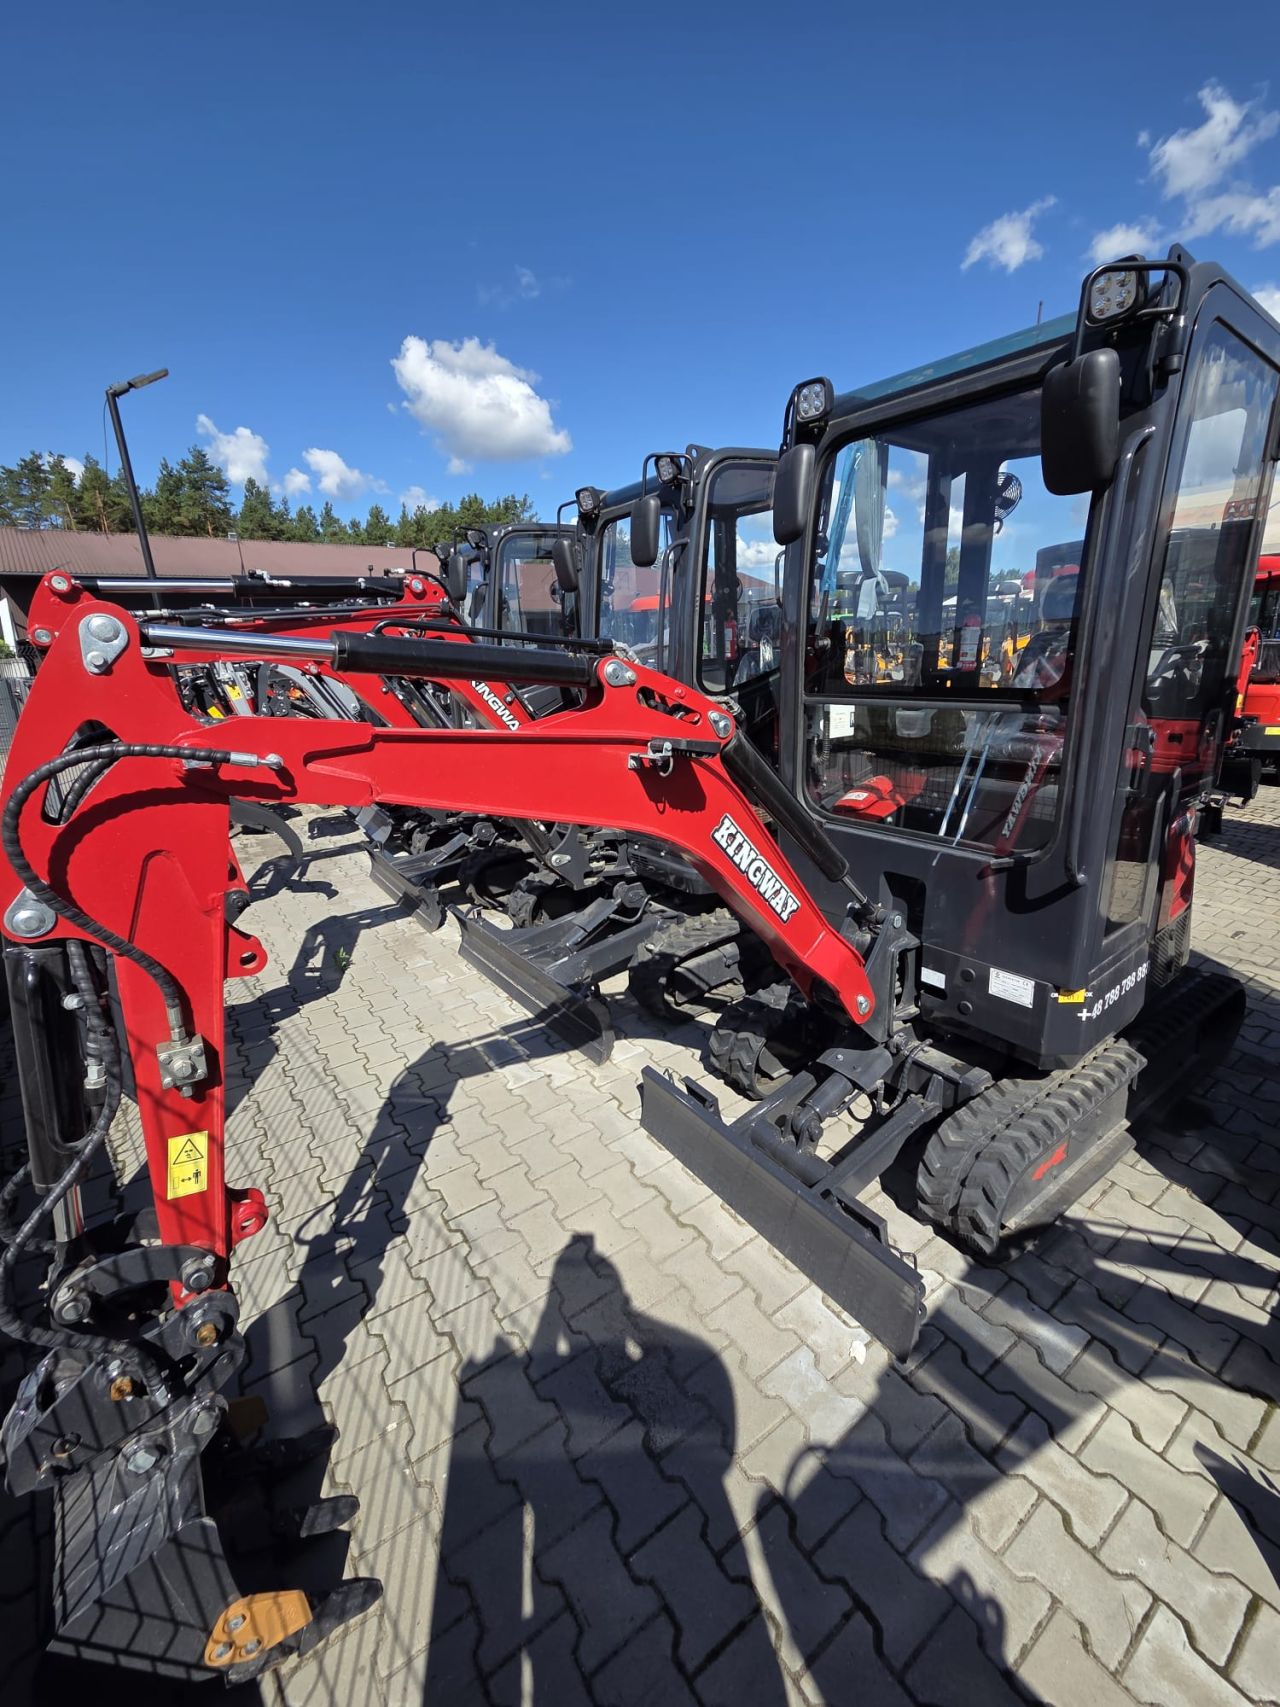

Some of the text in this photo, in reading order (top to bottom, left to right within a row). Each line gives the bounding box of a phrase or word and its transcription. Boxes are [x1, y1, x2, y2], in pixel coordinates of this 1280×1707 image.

[471, 680, 520, 731] INGWA
[711, 814, 800, 924] KINGWAY
[1077, 999, 1103, 1021] +48
[1104, 984, 1120, 1010] 788
[1121, 971, 1136, 996] 788
